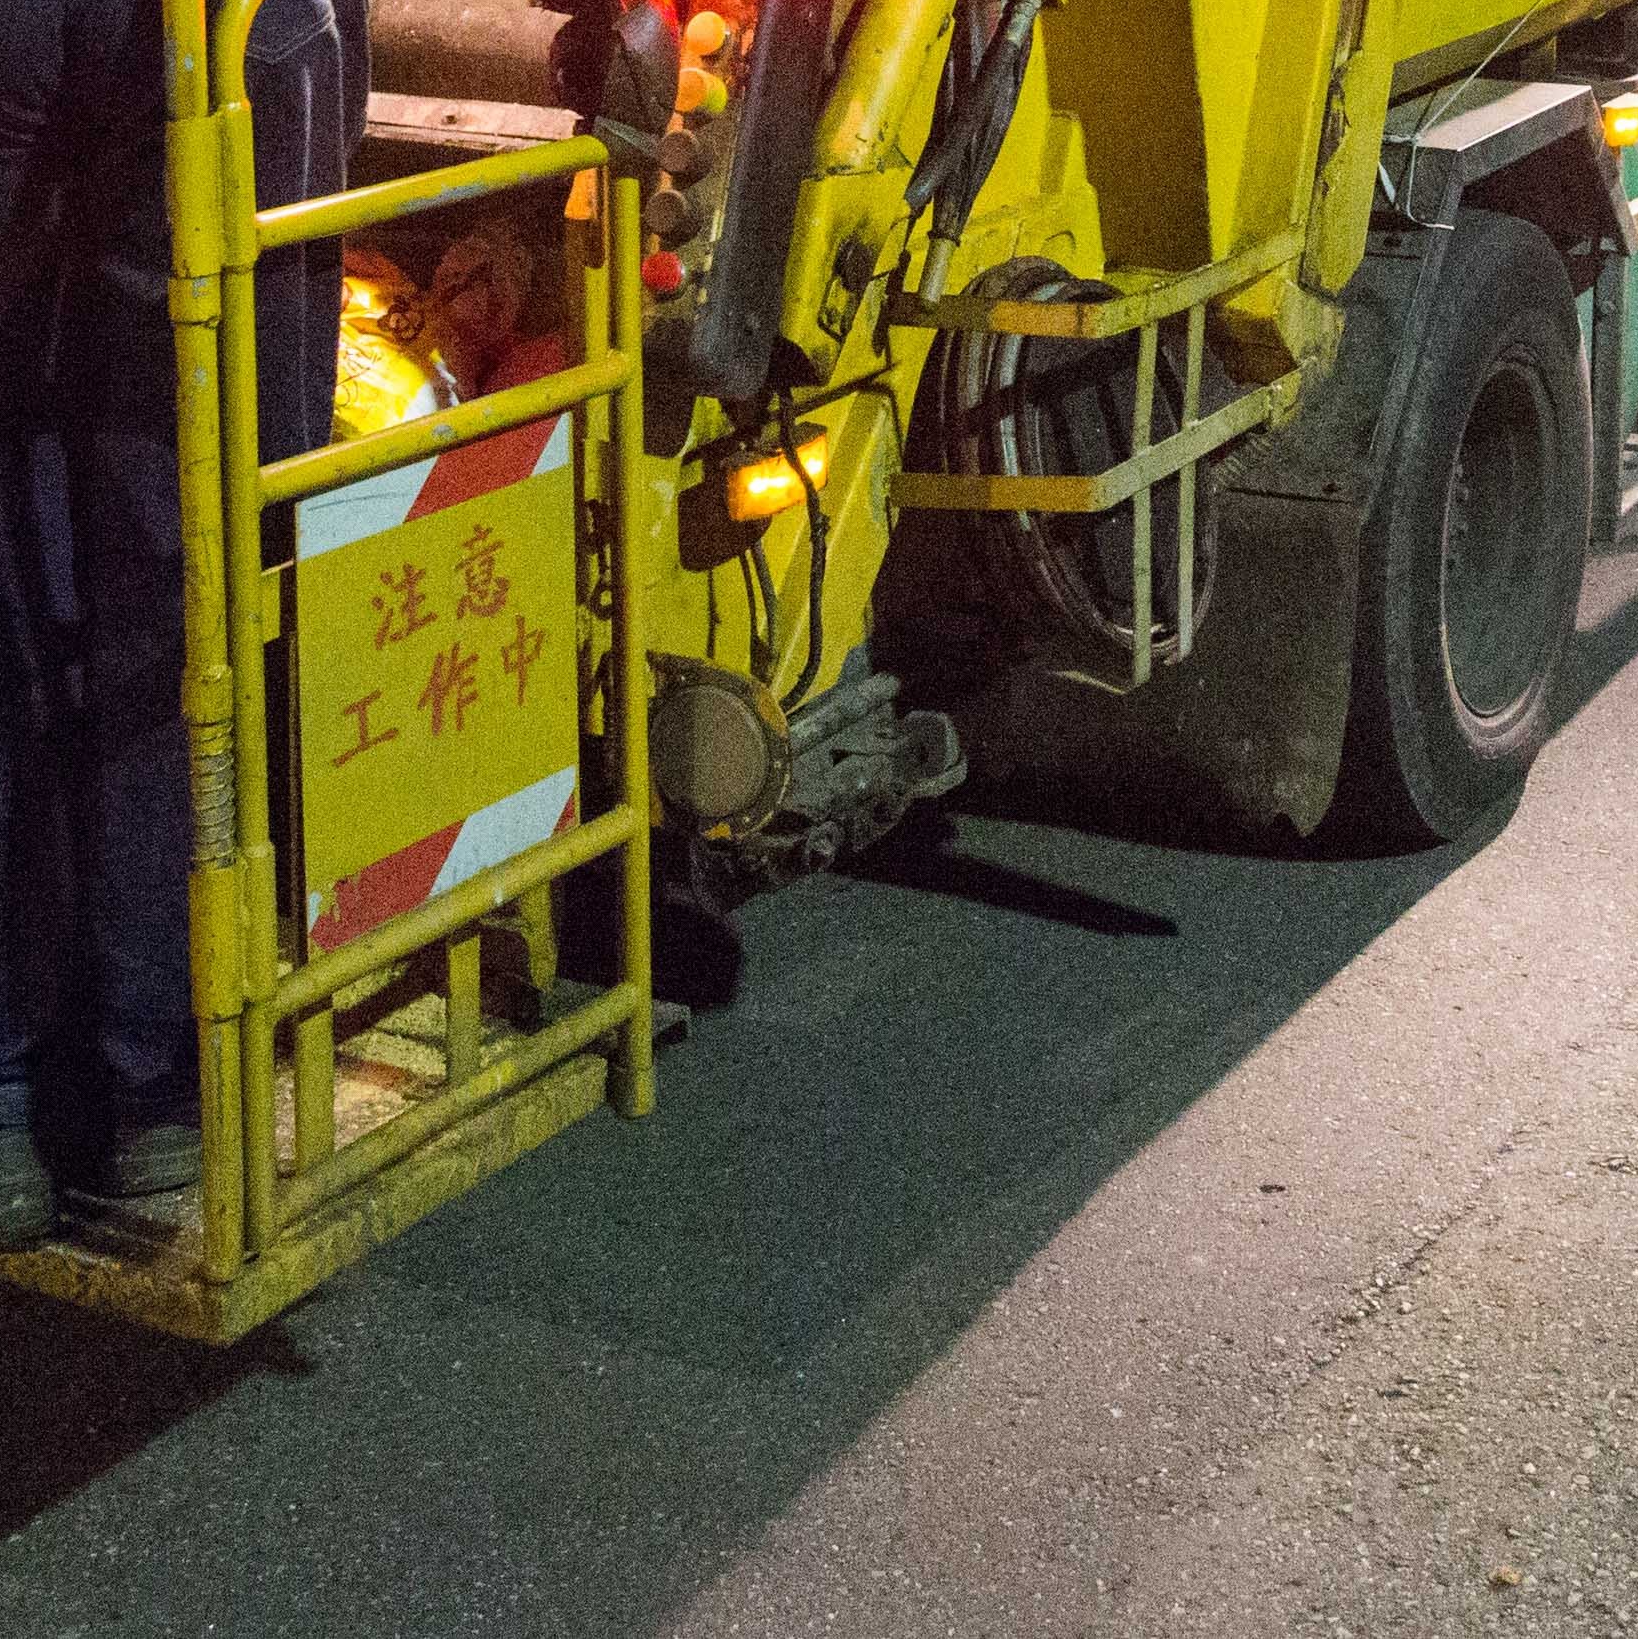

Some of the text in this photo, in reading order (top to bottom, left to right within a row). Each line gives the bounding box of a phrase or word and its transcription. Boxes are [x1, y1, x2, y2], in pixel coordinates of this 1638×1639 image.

[370, 523, 513, 651] 注意
[331, 614, 546, 768] 工作中
